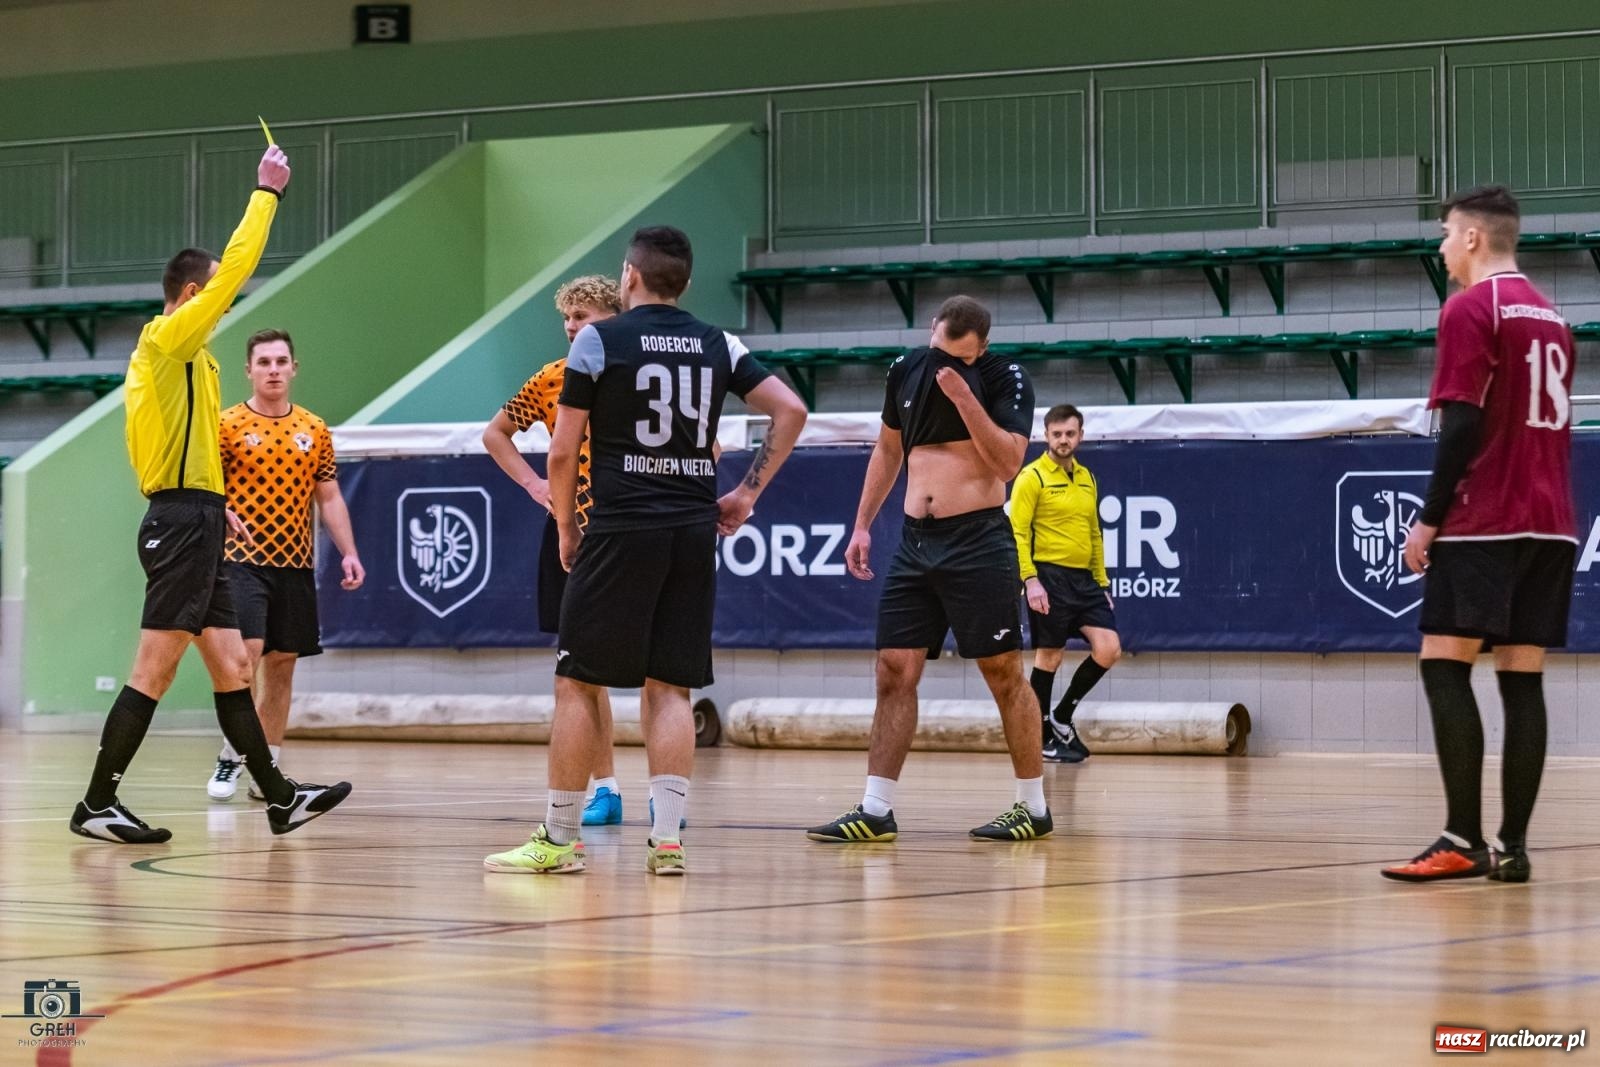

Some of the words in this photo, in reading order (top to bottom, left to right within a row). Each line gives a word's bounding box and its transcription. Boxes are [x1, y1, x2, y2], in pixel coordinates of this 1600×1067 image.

[368, 18, 397, 39] B
[640, 335, 703, 354] ROBERCIK
[635, 363, 713, 448] 34
[624, 455, 679, 476] BIOCHEM
[1099, 495, 1180, 569] iR
[1111, 571, 1181, 598] IBÓRZ
